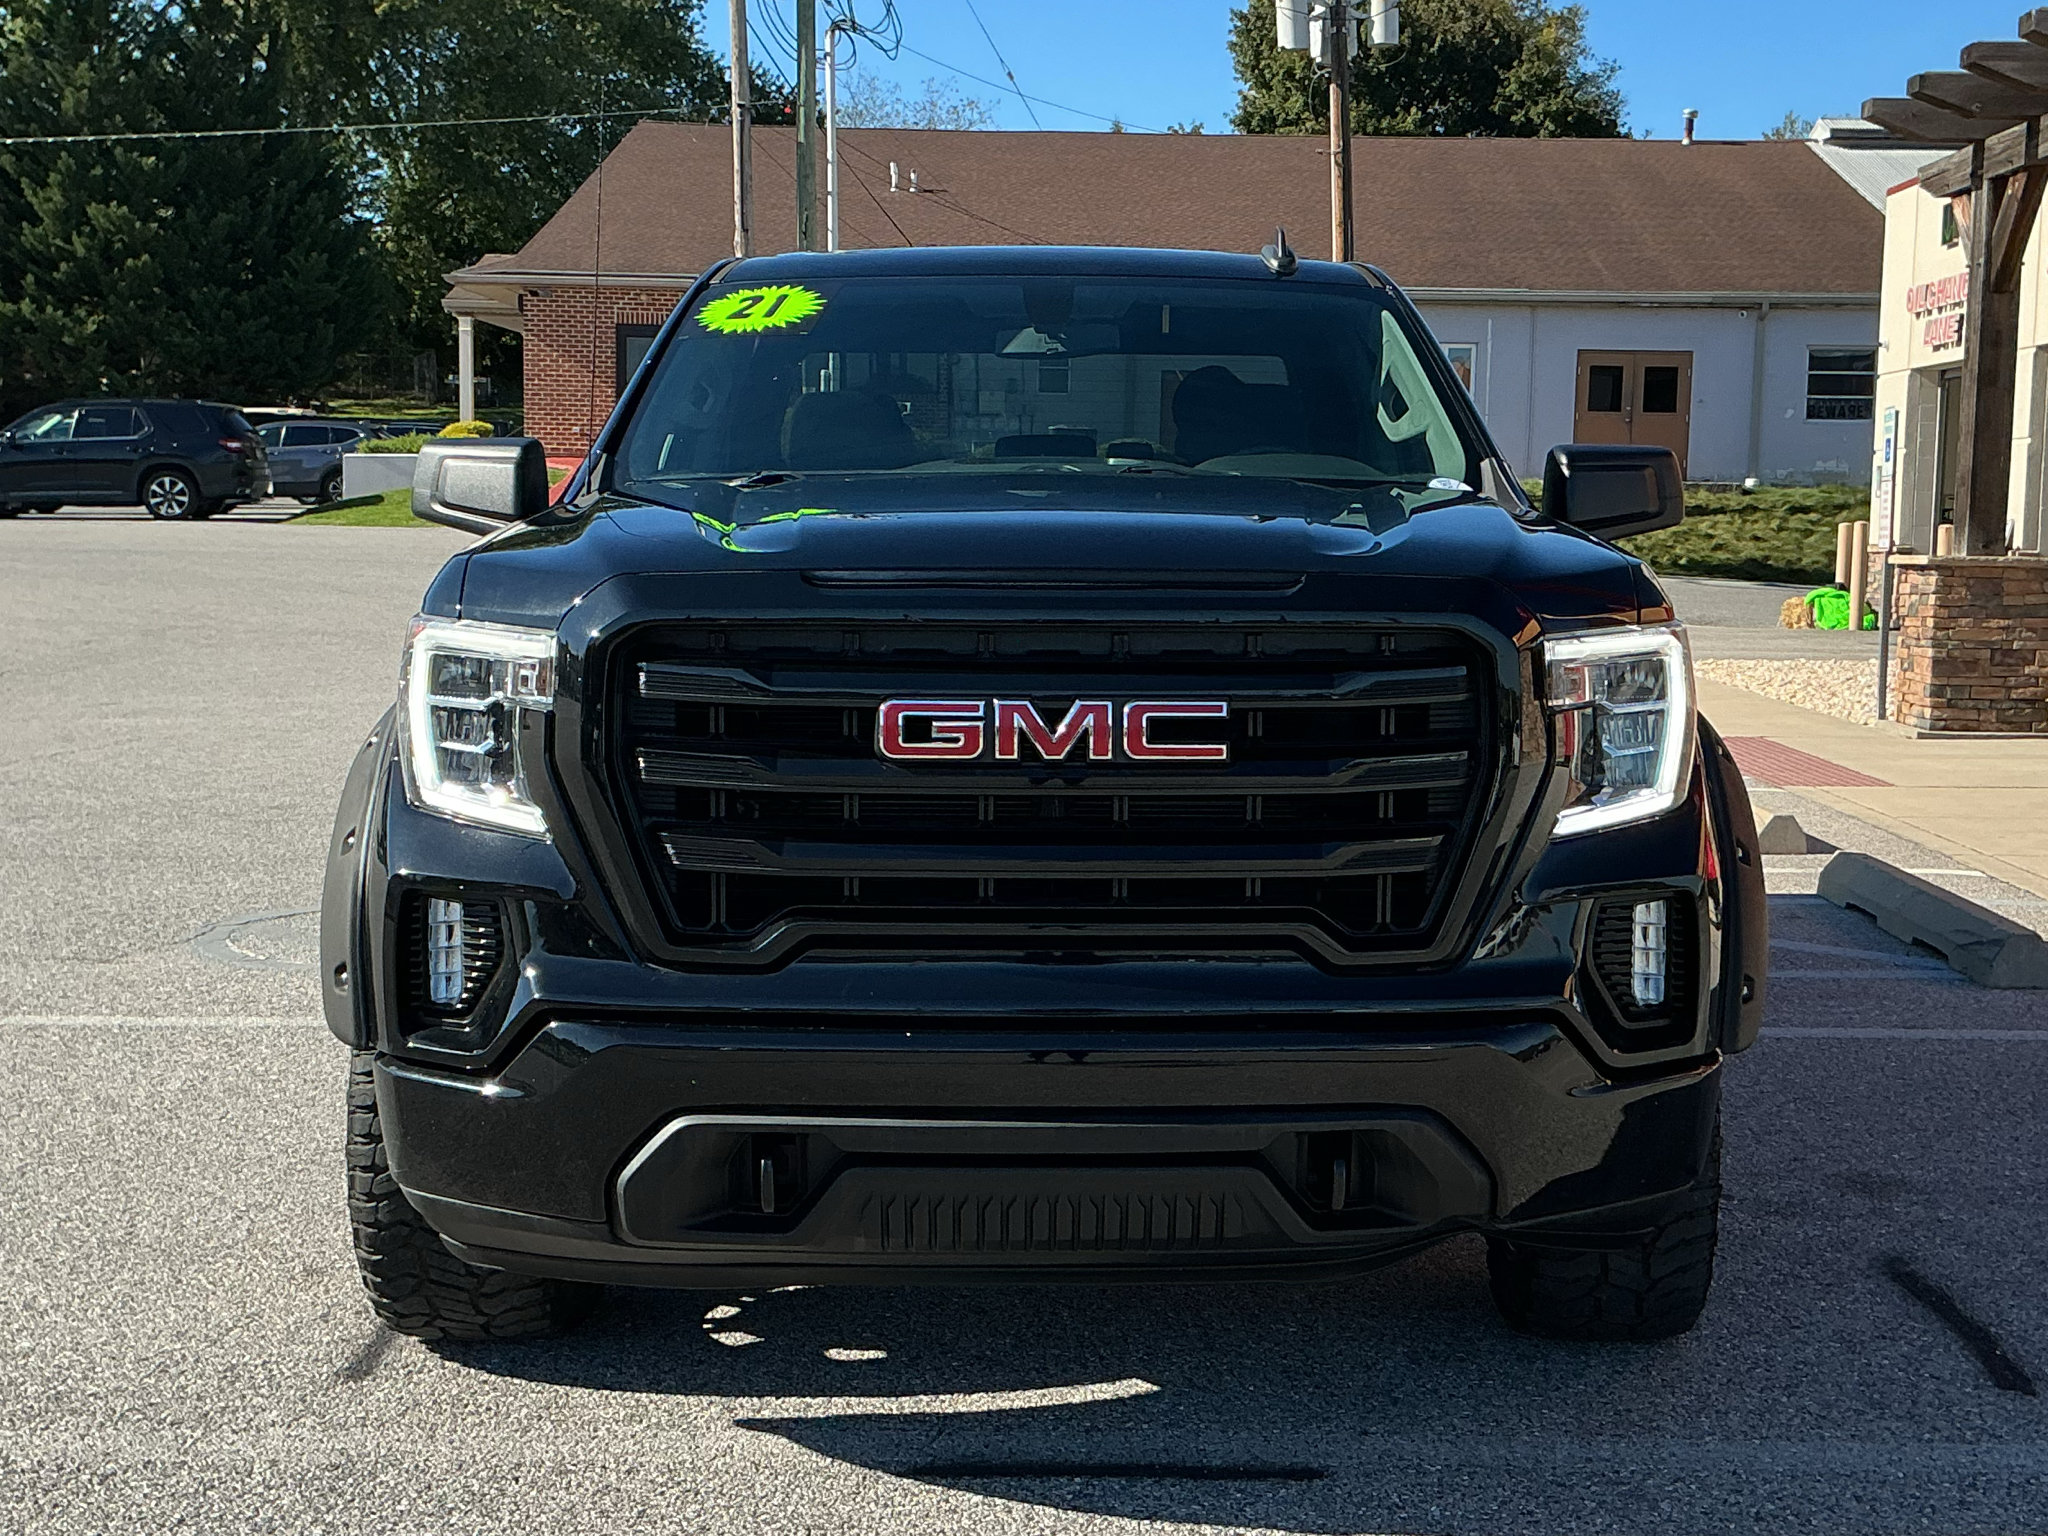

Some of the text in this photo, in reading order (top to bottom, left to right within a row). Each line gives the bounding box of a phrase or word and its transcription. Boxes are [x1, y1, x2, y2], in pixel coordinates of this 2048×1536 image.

[726, 294, 790, 319] 21
[1906, 272, 1968, 312] OIL CHANG
[1923, 314, 1959, 345] LANE
[878, 699, 1229, 760] GMC
